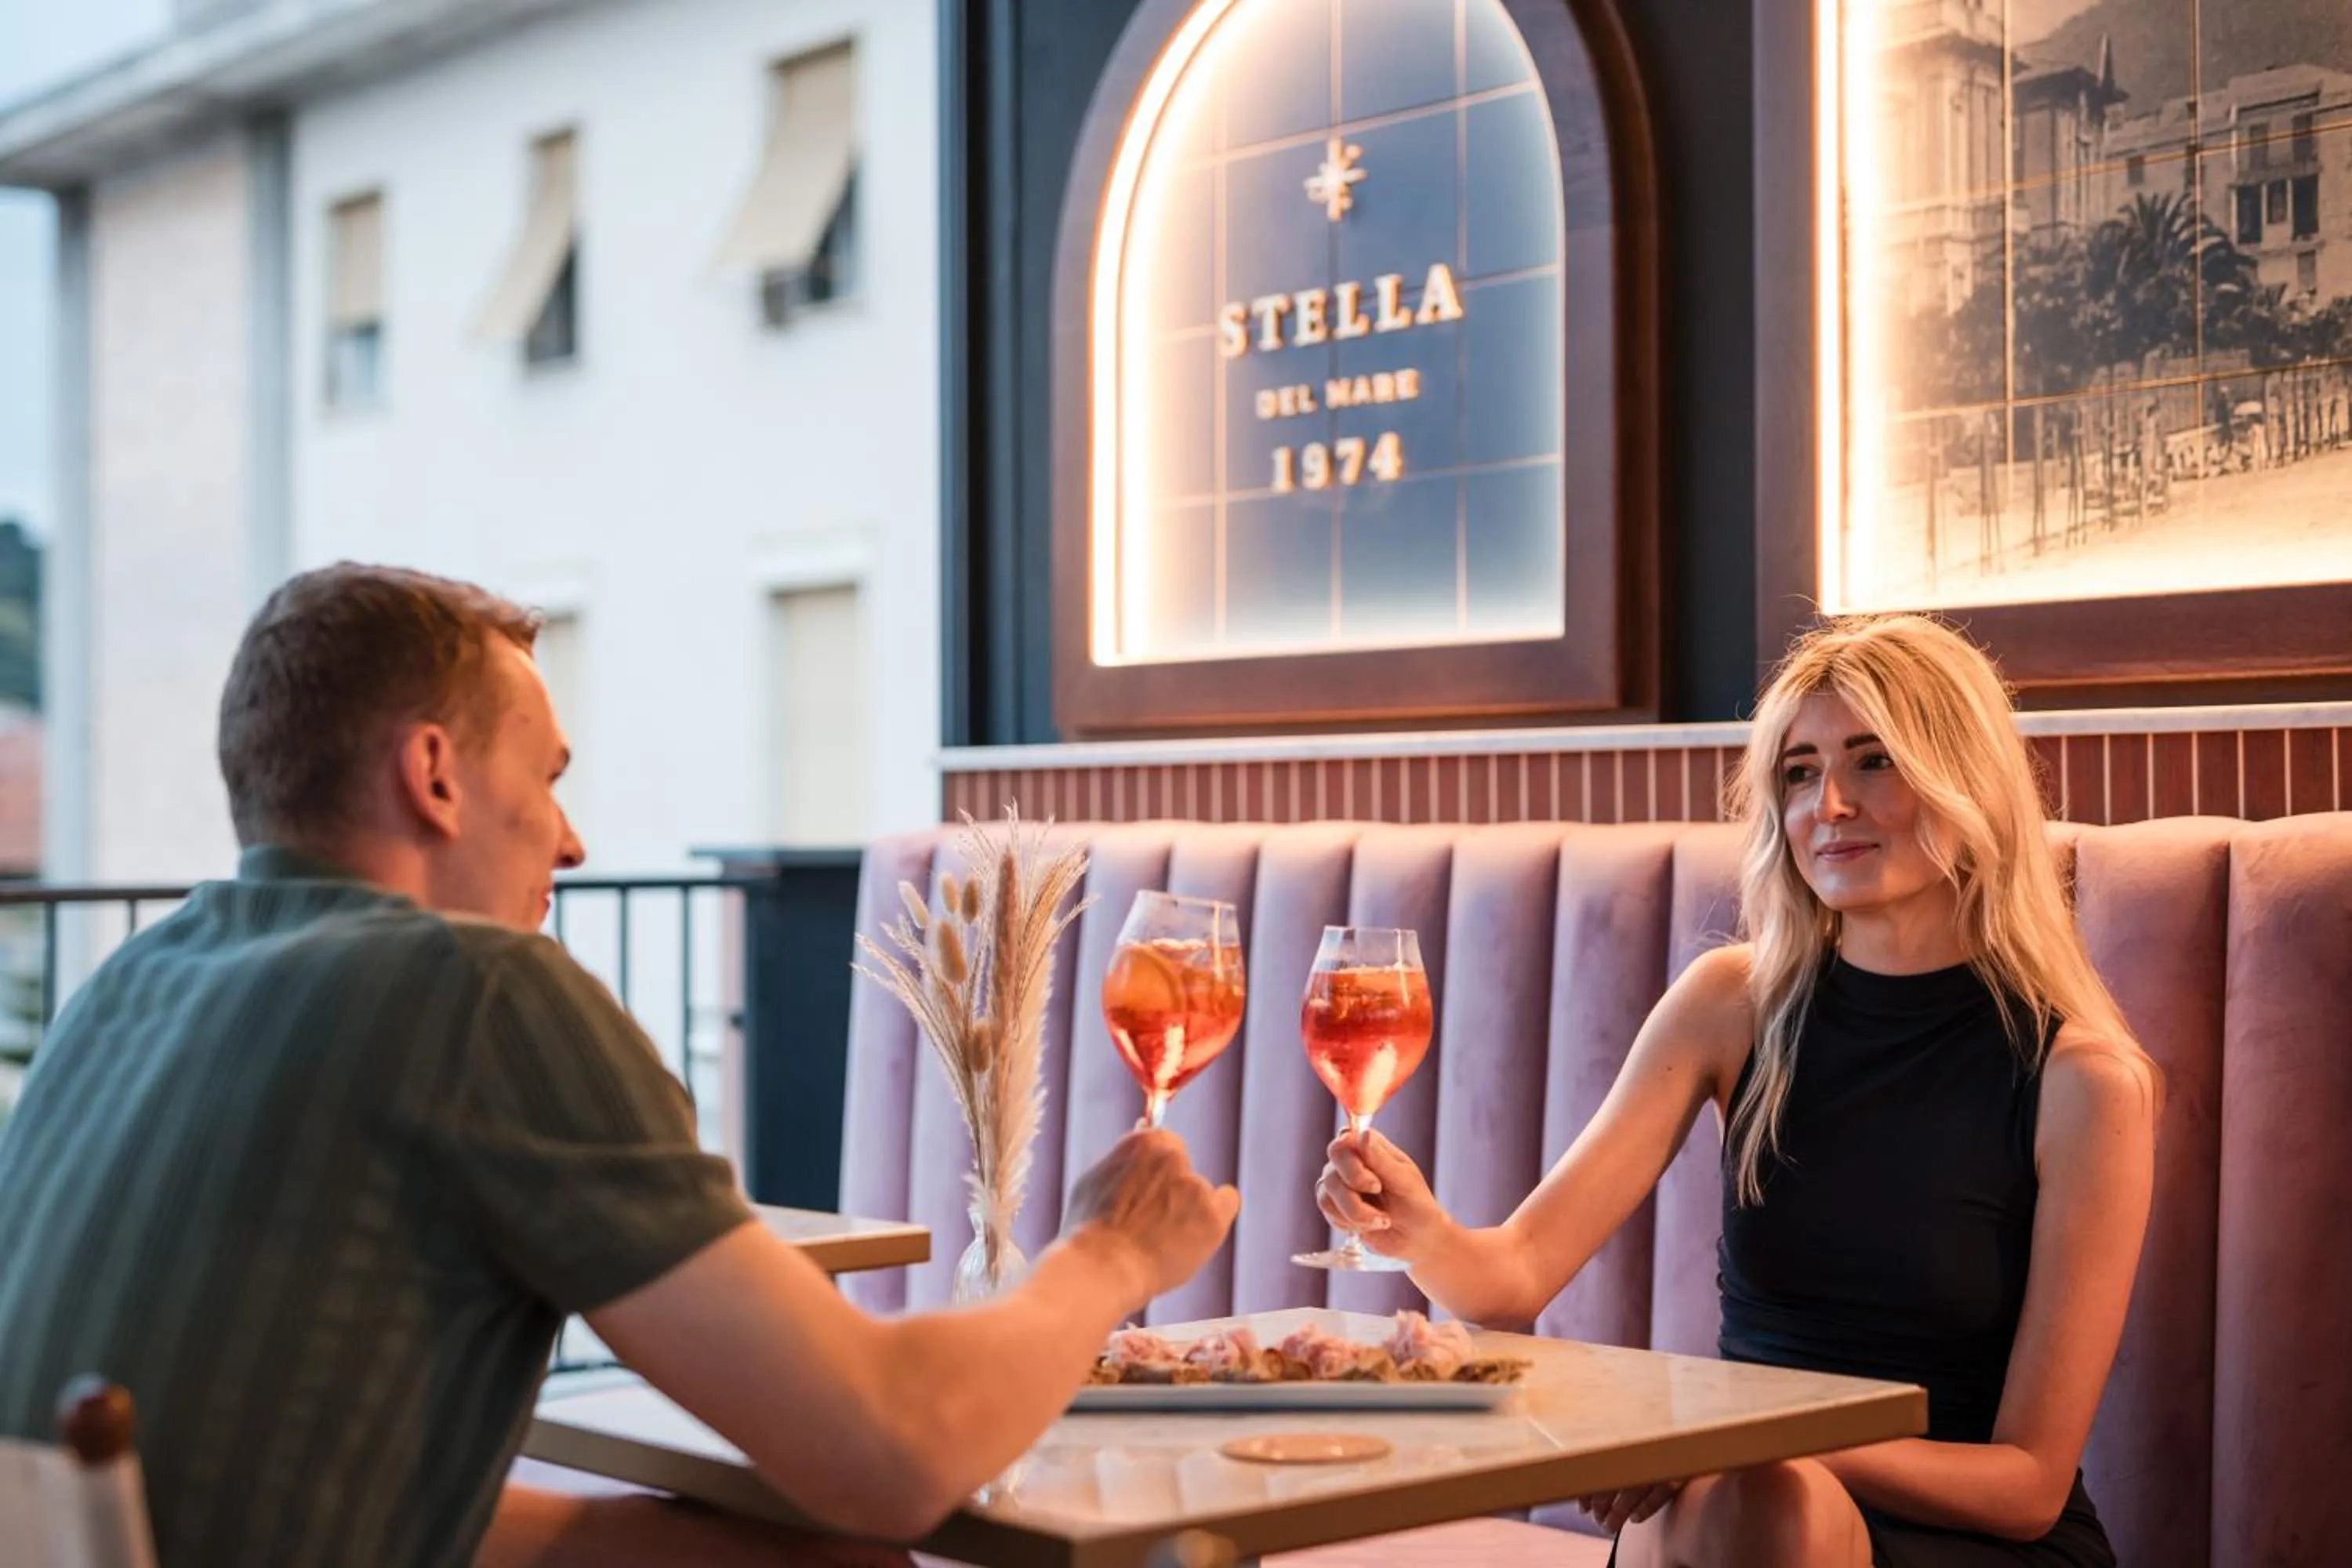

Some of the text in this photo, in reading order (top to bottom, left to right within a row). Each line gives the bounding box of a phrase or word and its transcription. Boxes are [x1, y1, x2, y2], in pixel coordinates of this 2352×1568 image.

[1218, 263, 1463, 358] STELLA
[1256, 368, 1420, 419] DEL MARE
[1272, 431, 1403, 493] 1974
